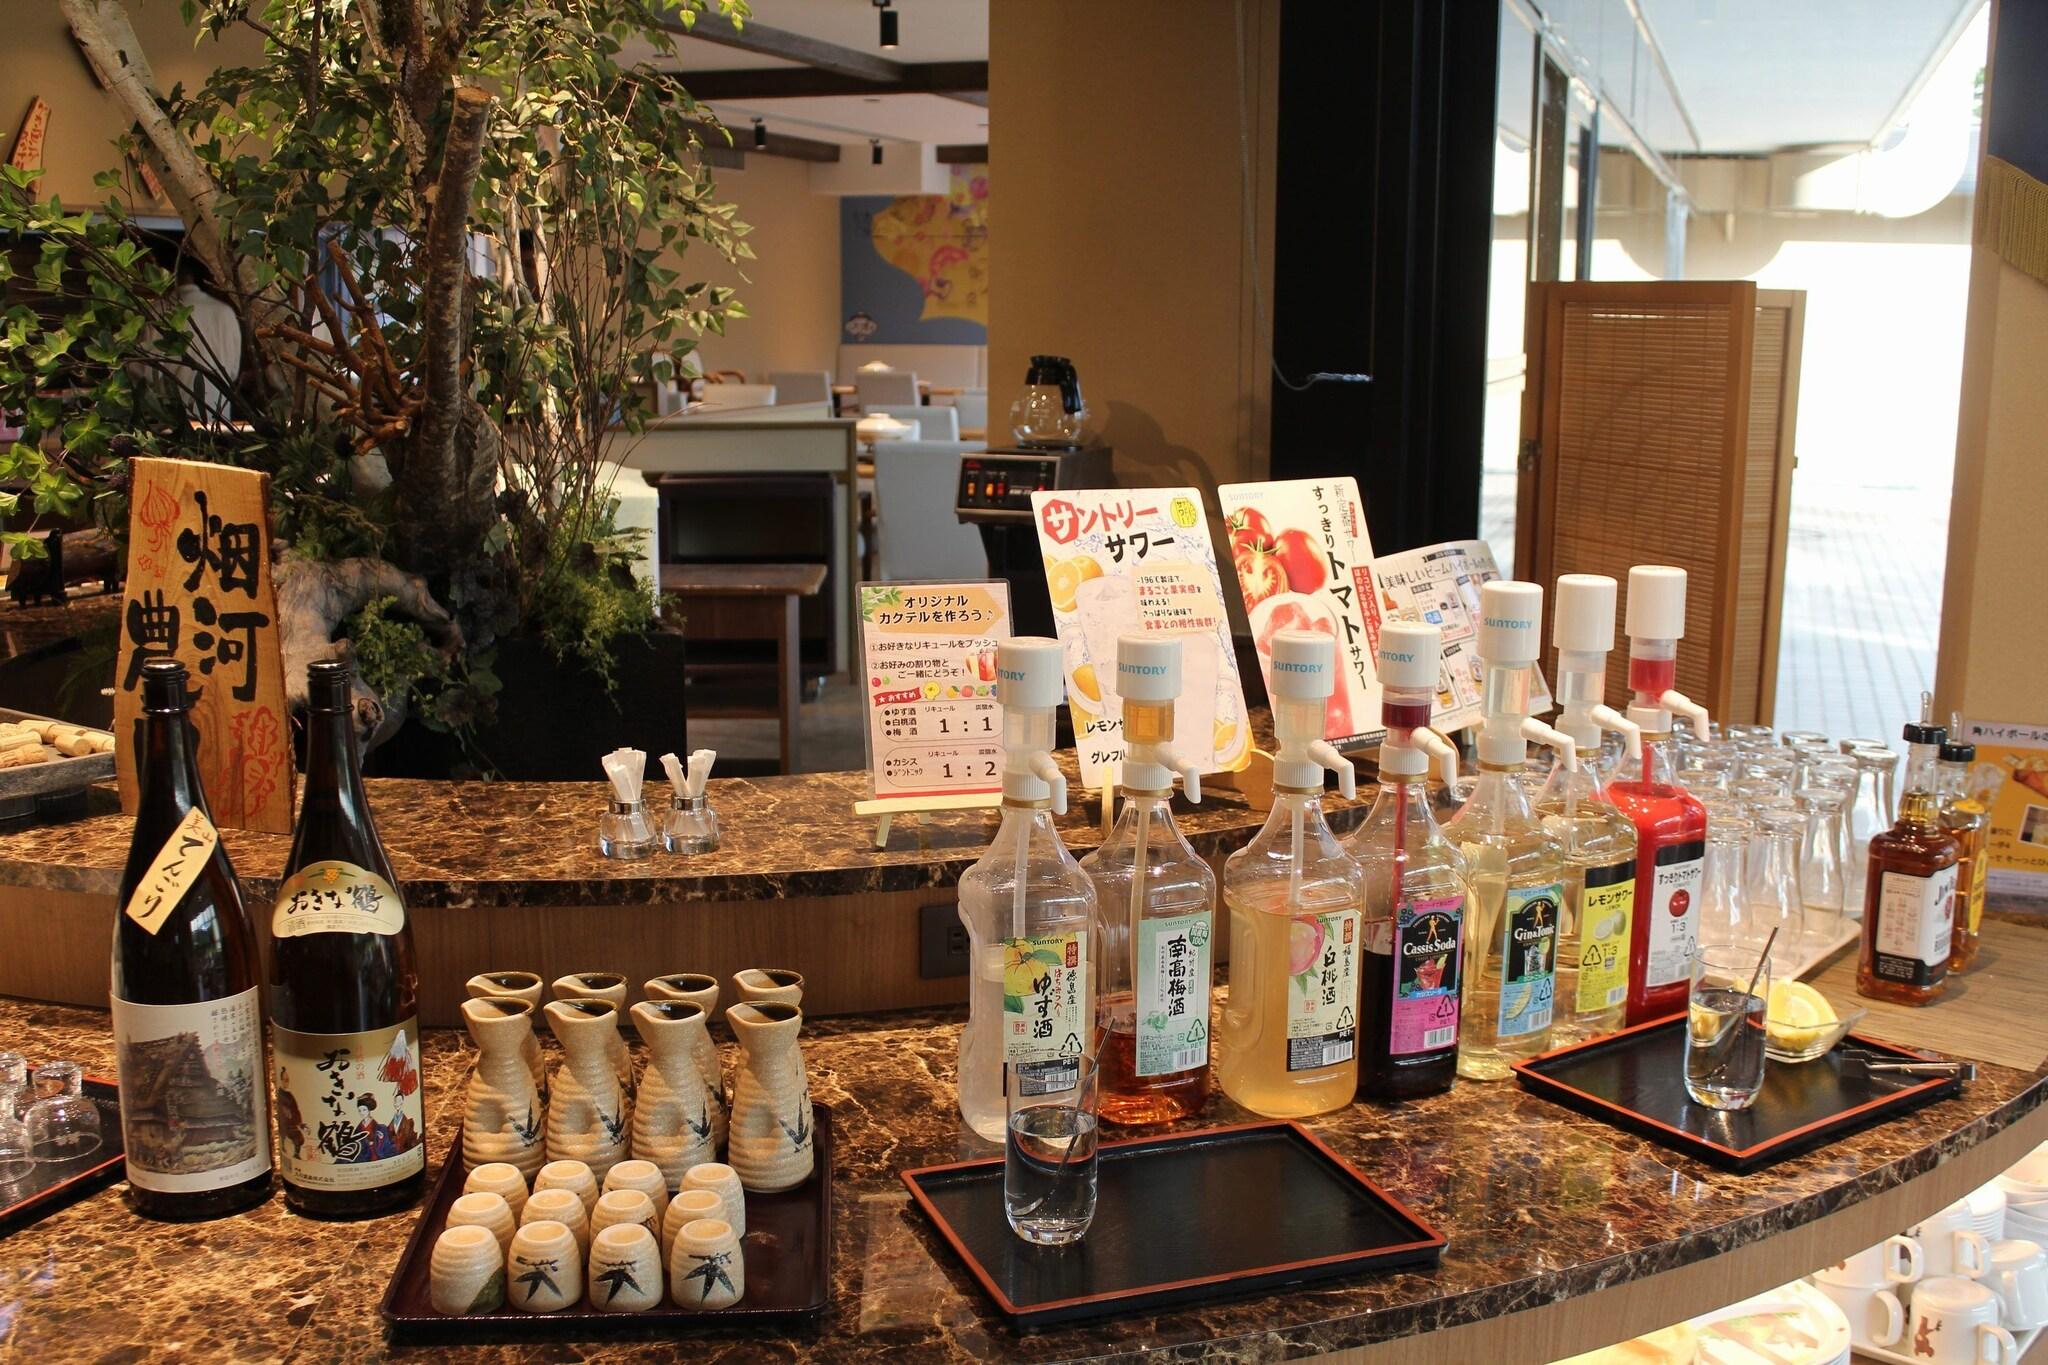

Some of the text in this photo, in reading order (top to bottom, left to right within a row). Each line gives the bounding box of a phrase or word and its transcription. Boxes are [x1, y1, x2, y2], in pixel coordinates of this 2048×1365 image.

[1043, 499, 1158, 541] サントリー
[1104, 531, 1175, 563] サワー
[904, 594, 968, 609] オリジナル
[879, 610, 982, 625] カクテルを作ろう
[1484, 617, 1533, 630] SUNTORY
[898, 668, 965, 679] ご一緒にどうぞ！
[1273, 660, 1323, 673] SUNTORY
[891, 707, 917, 716] ゆず酒
[892, 717, 917, 726] 白桃酒
[940, 718, 950, 733] 1
[982, 716, 993, 731] 1
[893, 758, 918, 767] カシス
[943, 763, 953, 778] 1
[985, 761, 996, 776] 2
[287, 884, 384, 914] おきな鶴
[1588, 889, 1633, 907] レモンサワー
[1032, 938, 1064, 946] SUNTORY
[1403, 937, 1457, 956] Cassis Soda
[1168, 934, 1187, 1017] 南高梅酒
[1321, 945, 1338, 1006] 白桃酒
[1032, 972, 1055, 1039] ゆず酒
[316, 1048, 370, 1164] おきな鶴
